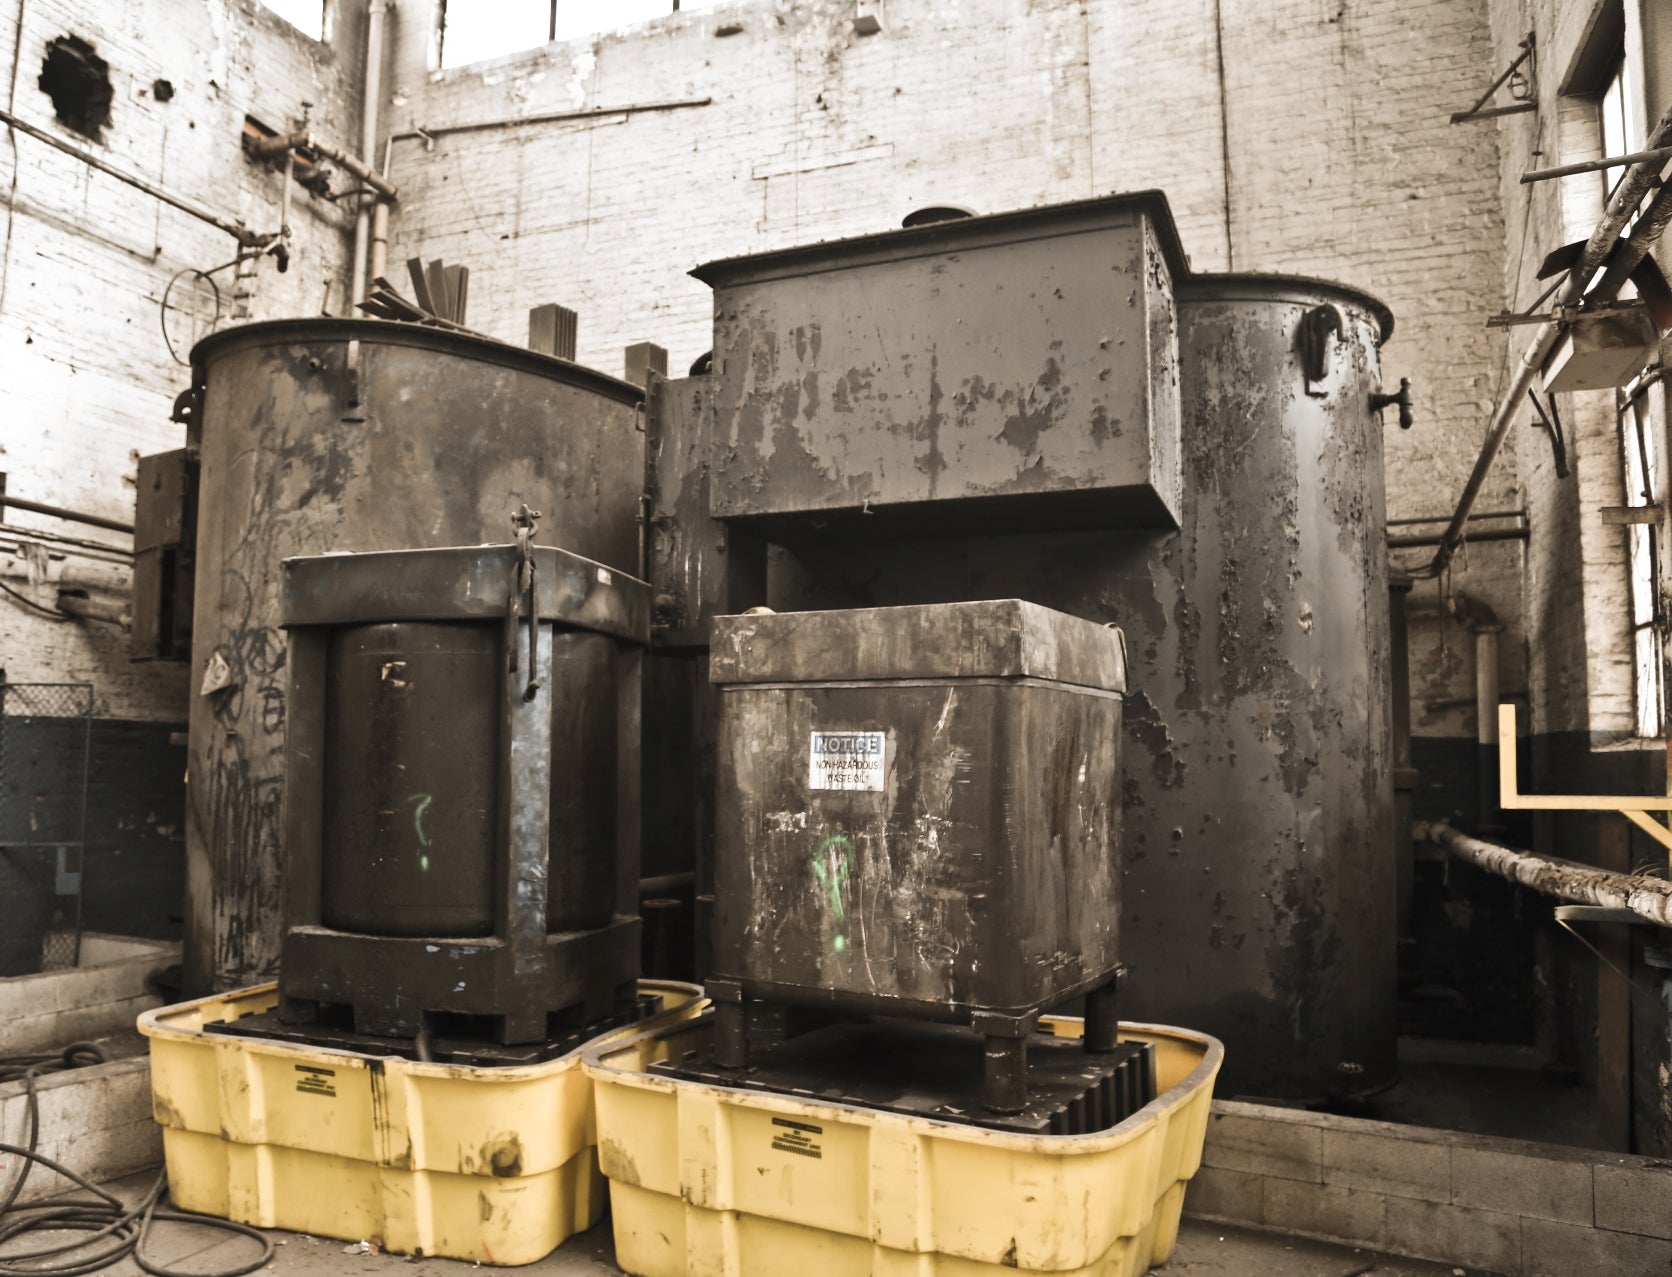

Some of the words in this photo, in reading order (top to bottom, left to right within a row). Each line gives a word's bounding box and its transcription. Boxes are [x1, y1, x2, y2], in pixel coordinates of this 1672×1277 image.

[816, 737, 879, 753] NOTICE
[827, 774, 851, 783] WASTE
[853, 774, 865, 783] OIL
